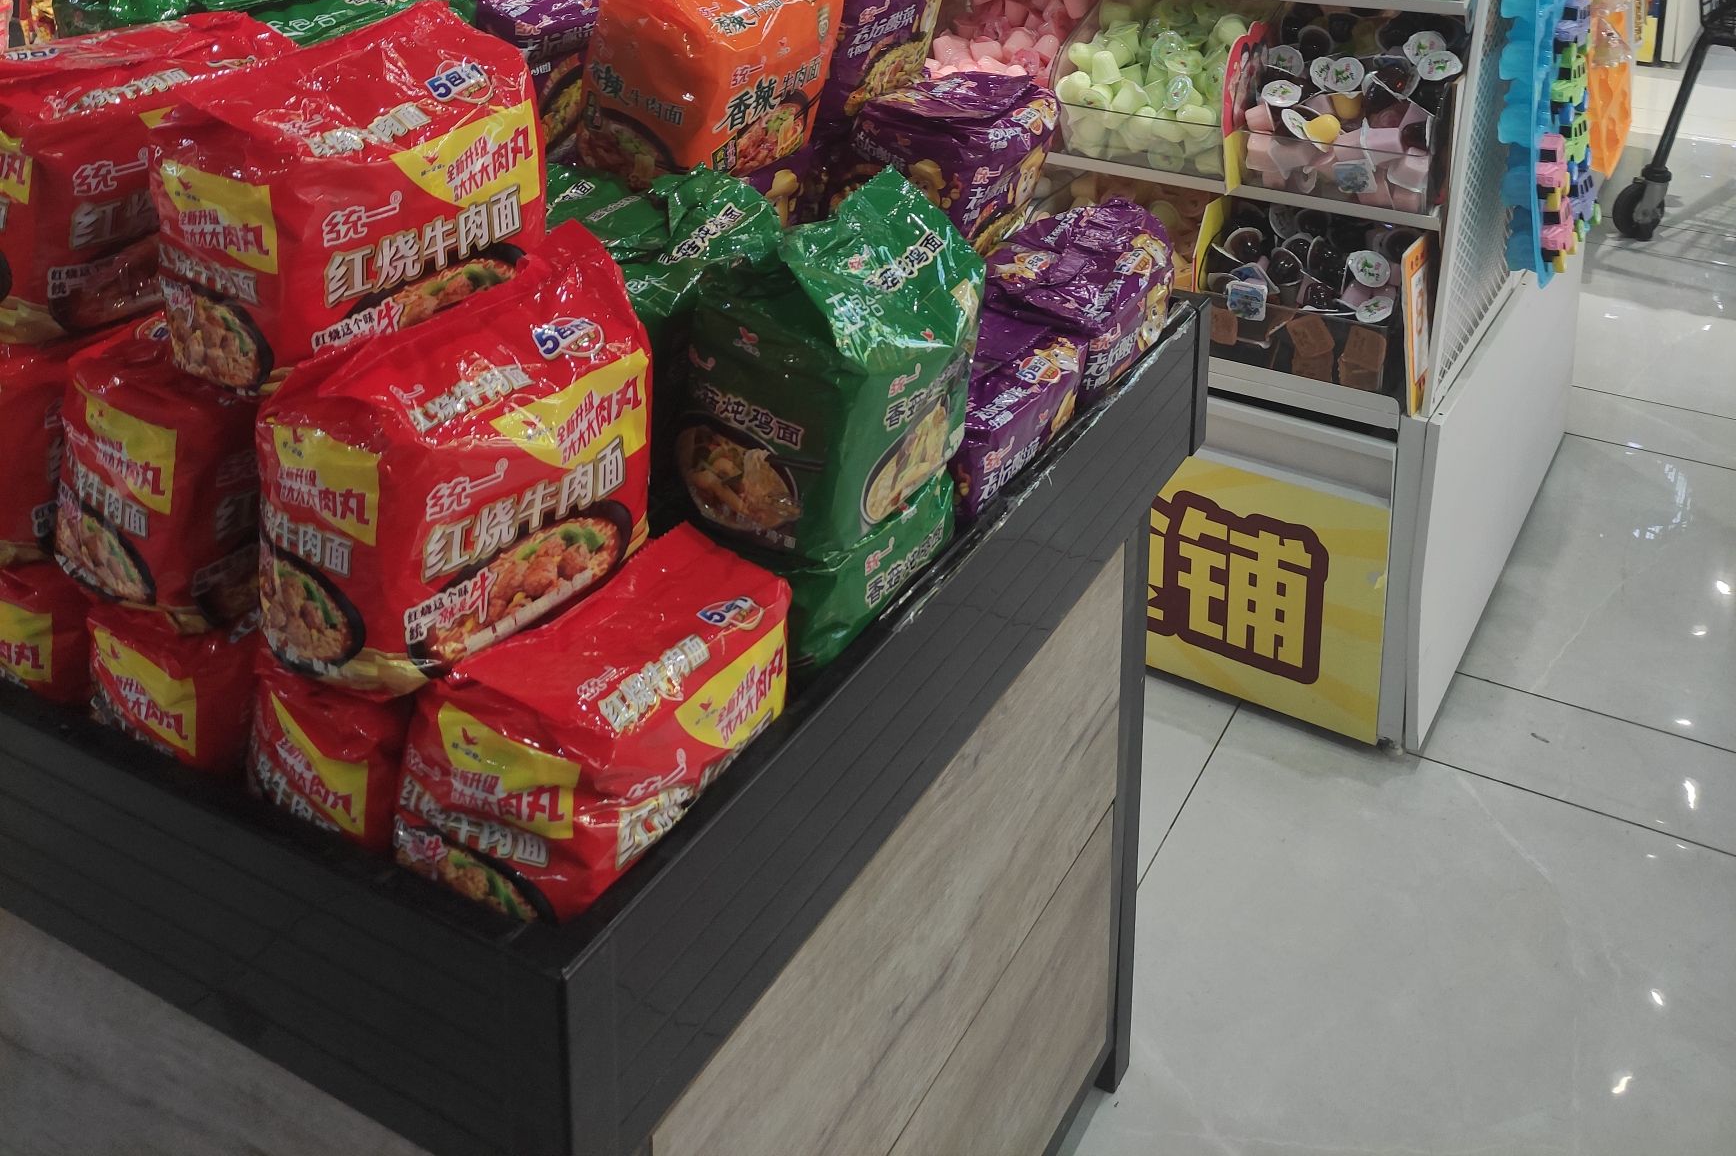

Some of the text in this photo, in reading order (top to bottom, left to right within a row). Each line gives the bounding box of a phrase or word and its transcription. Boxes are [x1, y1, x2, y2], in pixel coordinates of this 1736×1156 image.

[713, 55, 824, 134] 香辣牛肉面
[731, 57, 766, 88] 统一
[323, 200, 402, 246] 统一
[325, 185, 522, 309] 红烧牛肉面
[422, 436, 626, 583] 红烧牛肉面
[426, 472, 506, 523] 统一
[408, 585, 469, 625] 红烧这个味
